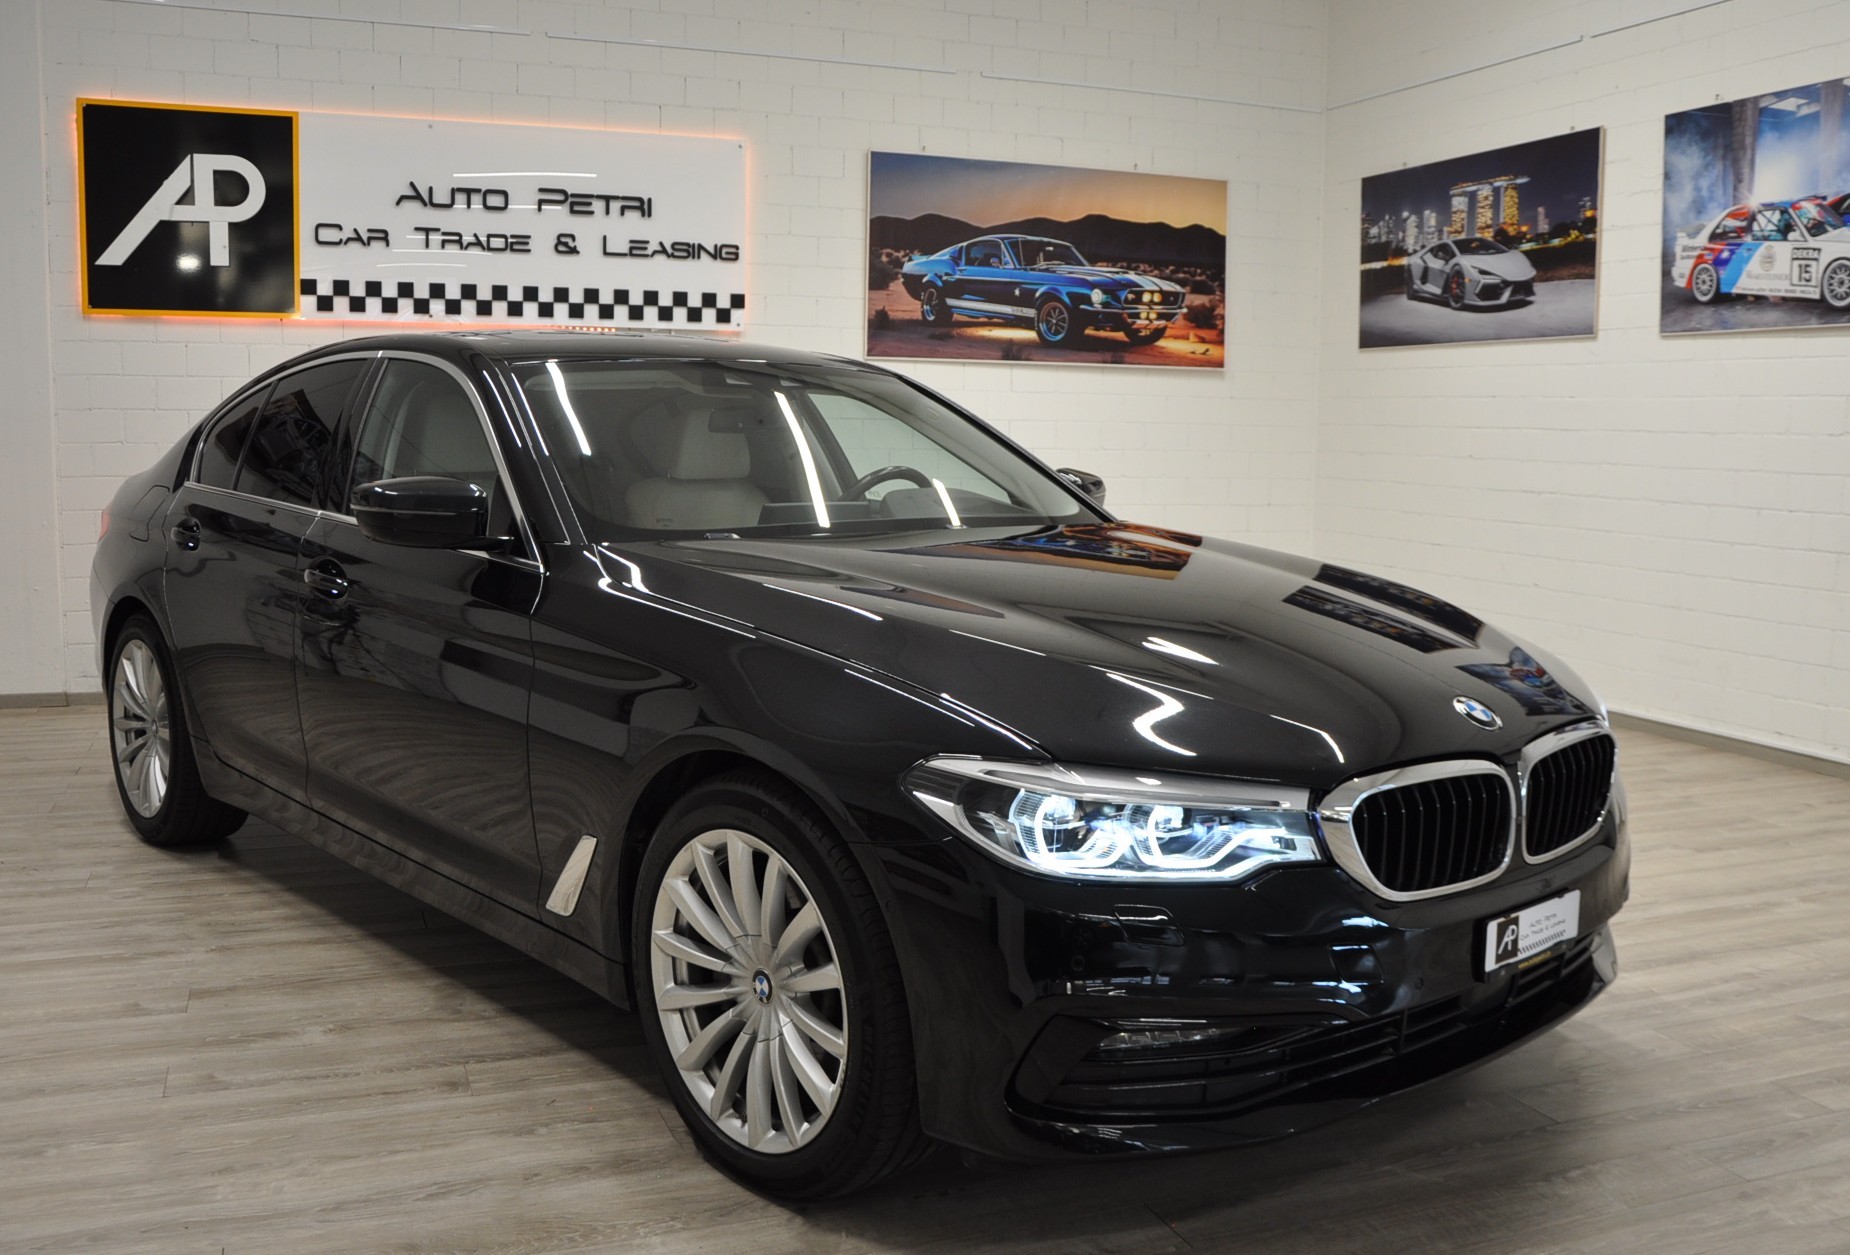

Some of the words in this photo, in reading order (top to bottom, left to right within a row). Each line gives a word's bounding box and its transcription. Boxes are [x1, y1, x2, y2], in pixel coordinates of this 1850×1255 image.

[94, 153, 266, 266] AP
[395, 181, 509, 211] AUTO
[537, 187, 652, 218] PETRI
[314, 222, 390, 248] CAR
[413, 226, 532, 253] TRADE
[554, 232, 580, 255] &
[602, 234, 740, 262] LEASING
[1797, 263, 1812, 283] 15
